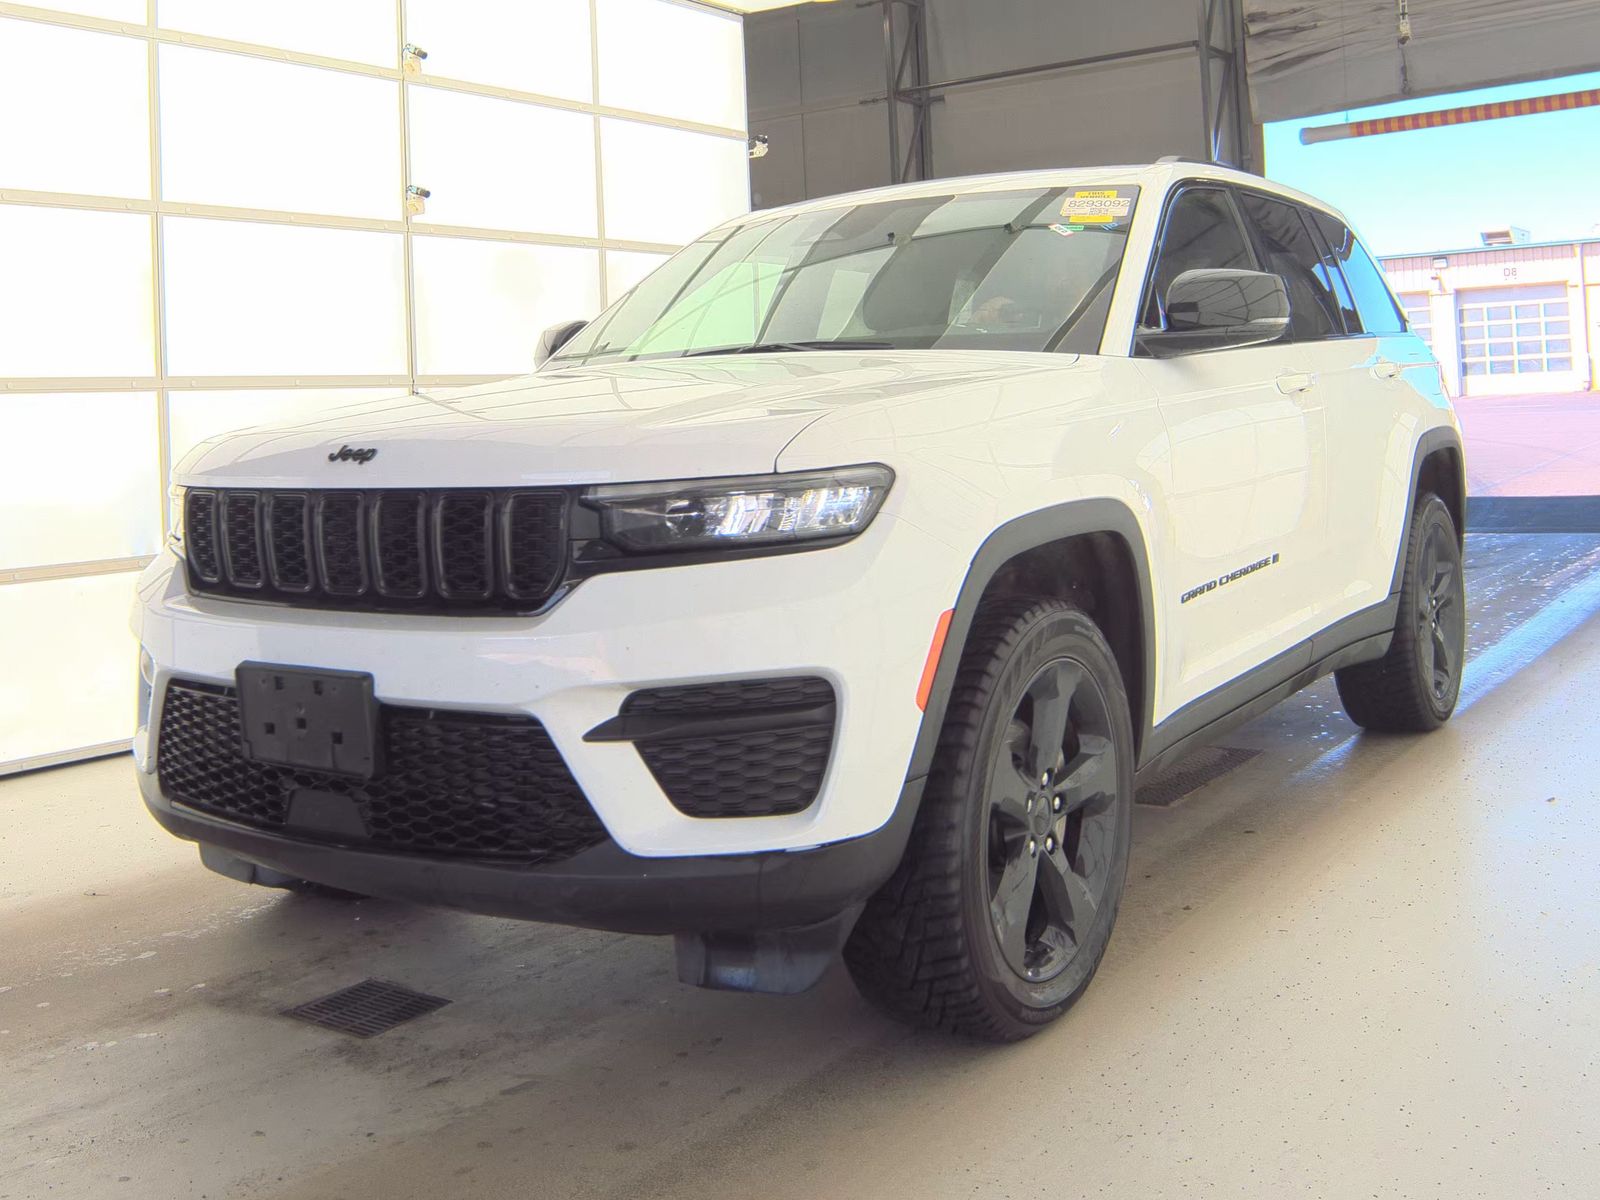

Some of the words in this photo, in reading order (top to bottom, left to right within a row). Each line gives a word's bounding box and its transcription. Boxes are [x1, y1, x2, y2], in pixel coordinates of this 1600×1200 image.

[1068, 199, 1130, 208] 8293092
[328, 444, 377, 465] Jeep
[1181, 579, 1217, 604] GRAND
[1218, 557, 1271, 586] CHEROKEE
